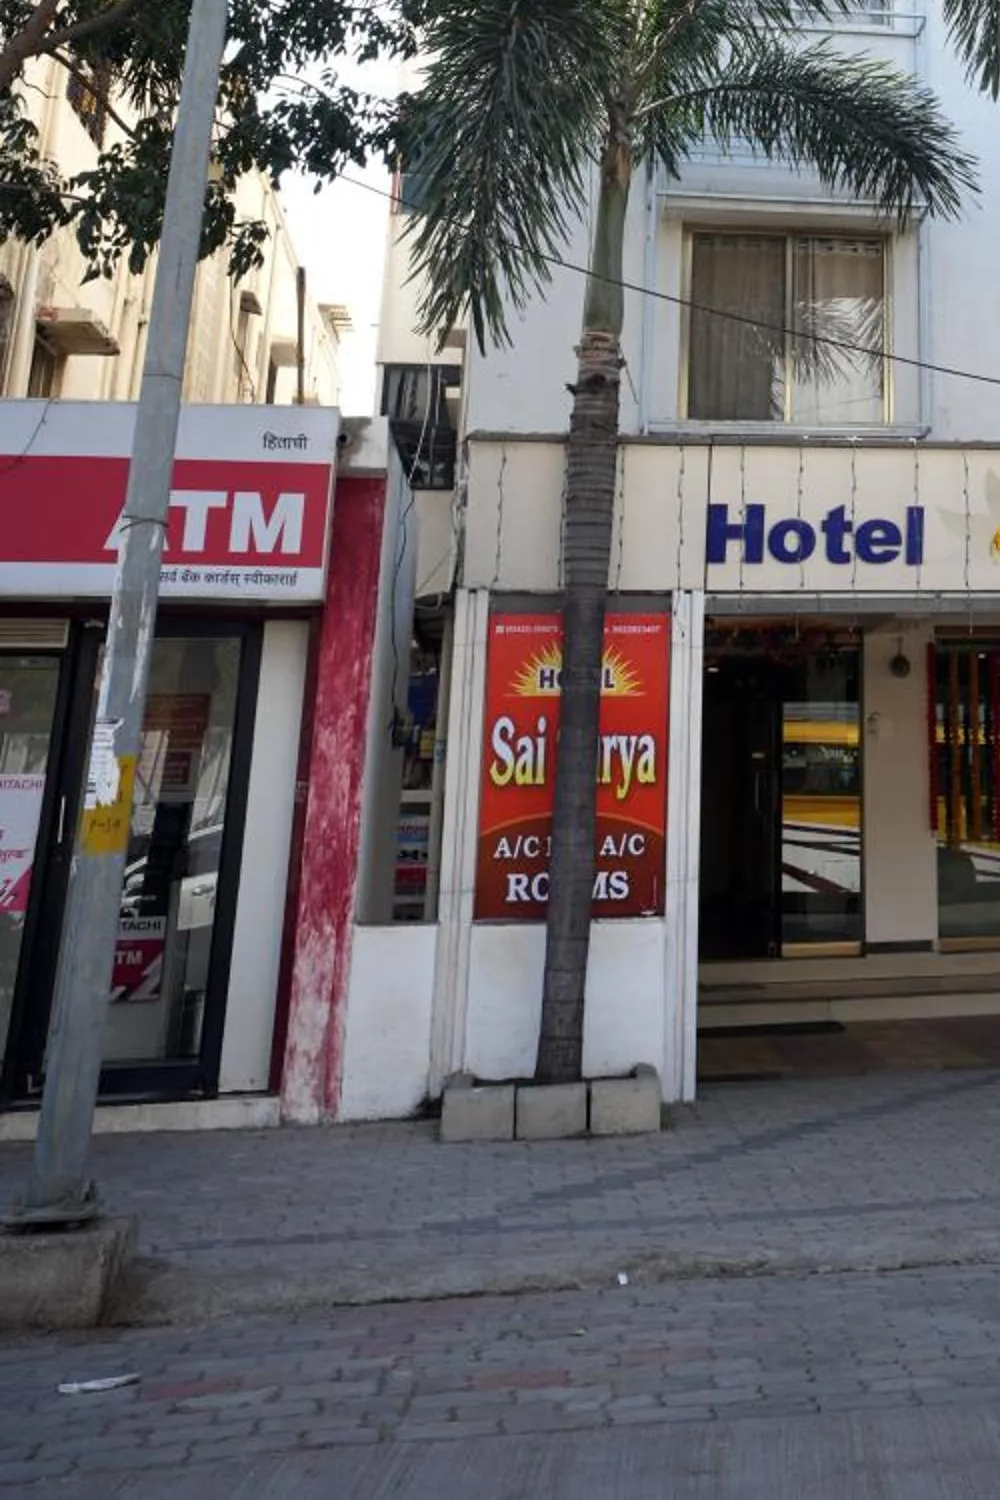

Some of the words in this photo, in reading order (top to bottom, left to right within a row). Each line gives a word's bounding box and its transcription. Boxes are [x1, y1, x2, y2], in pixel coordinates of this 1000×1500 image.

[705, 504, 924, 565] Hotel
[489, 716, 546, 786] Sai
[556, 729, 656, 800] rya
[0, 779, 43, 789] ITACHI
[493, 835, 540, 859] A/C
[599, 833, 645, 857] A/C
[506, 871, 630, 902] ROMS
[121, 921, 161, 931] TACHI
[115, 950, 143, 965] TM
